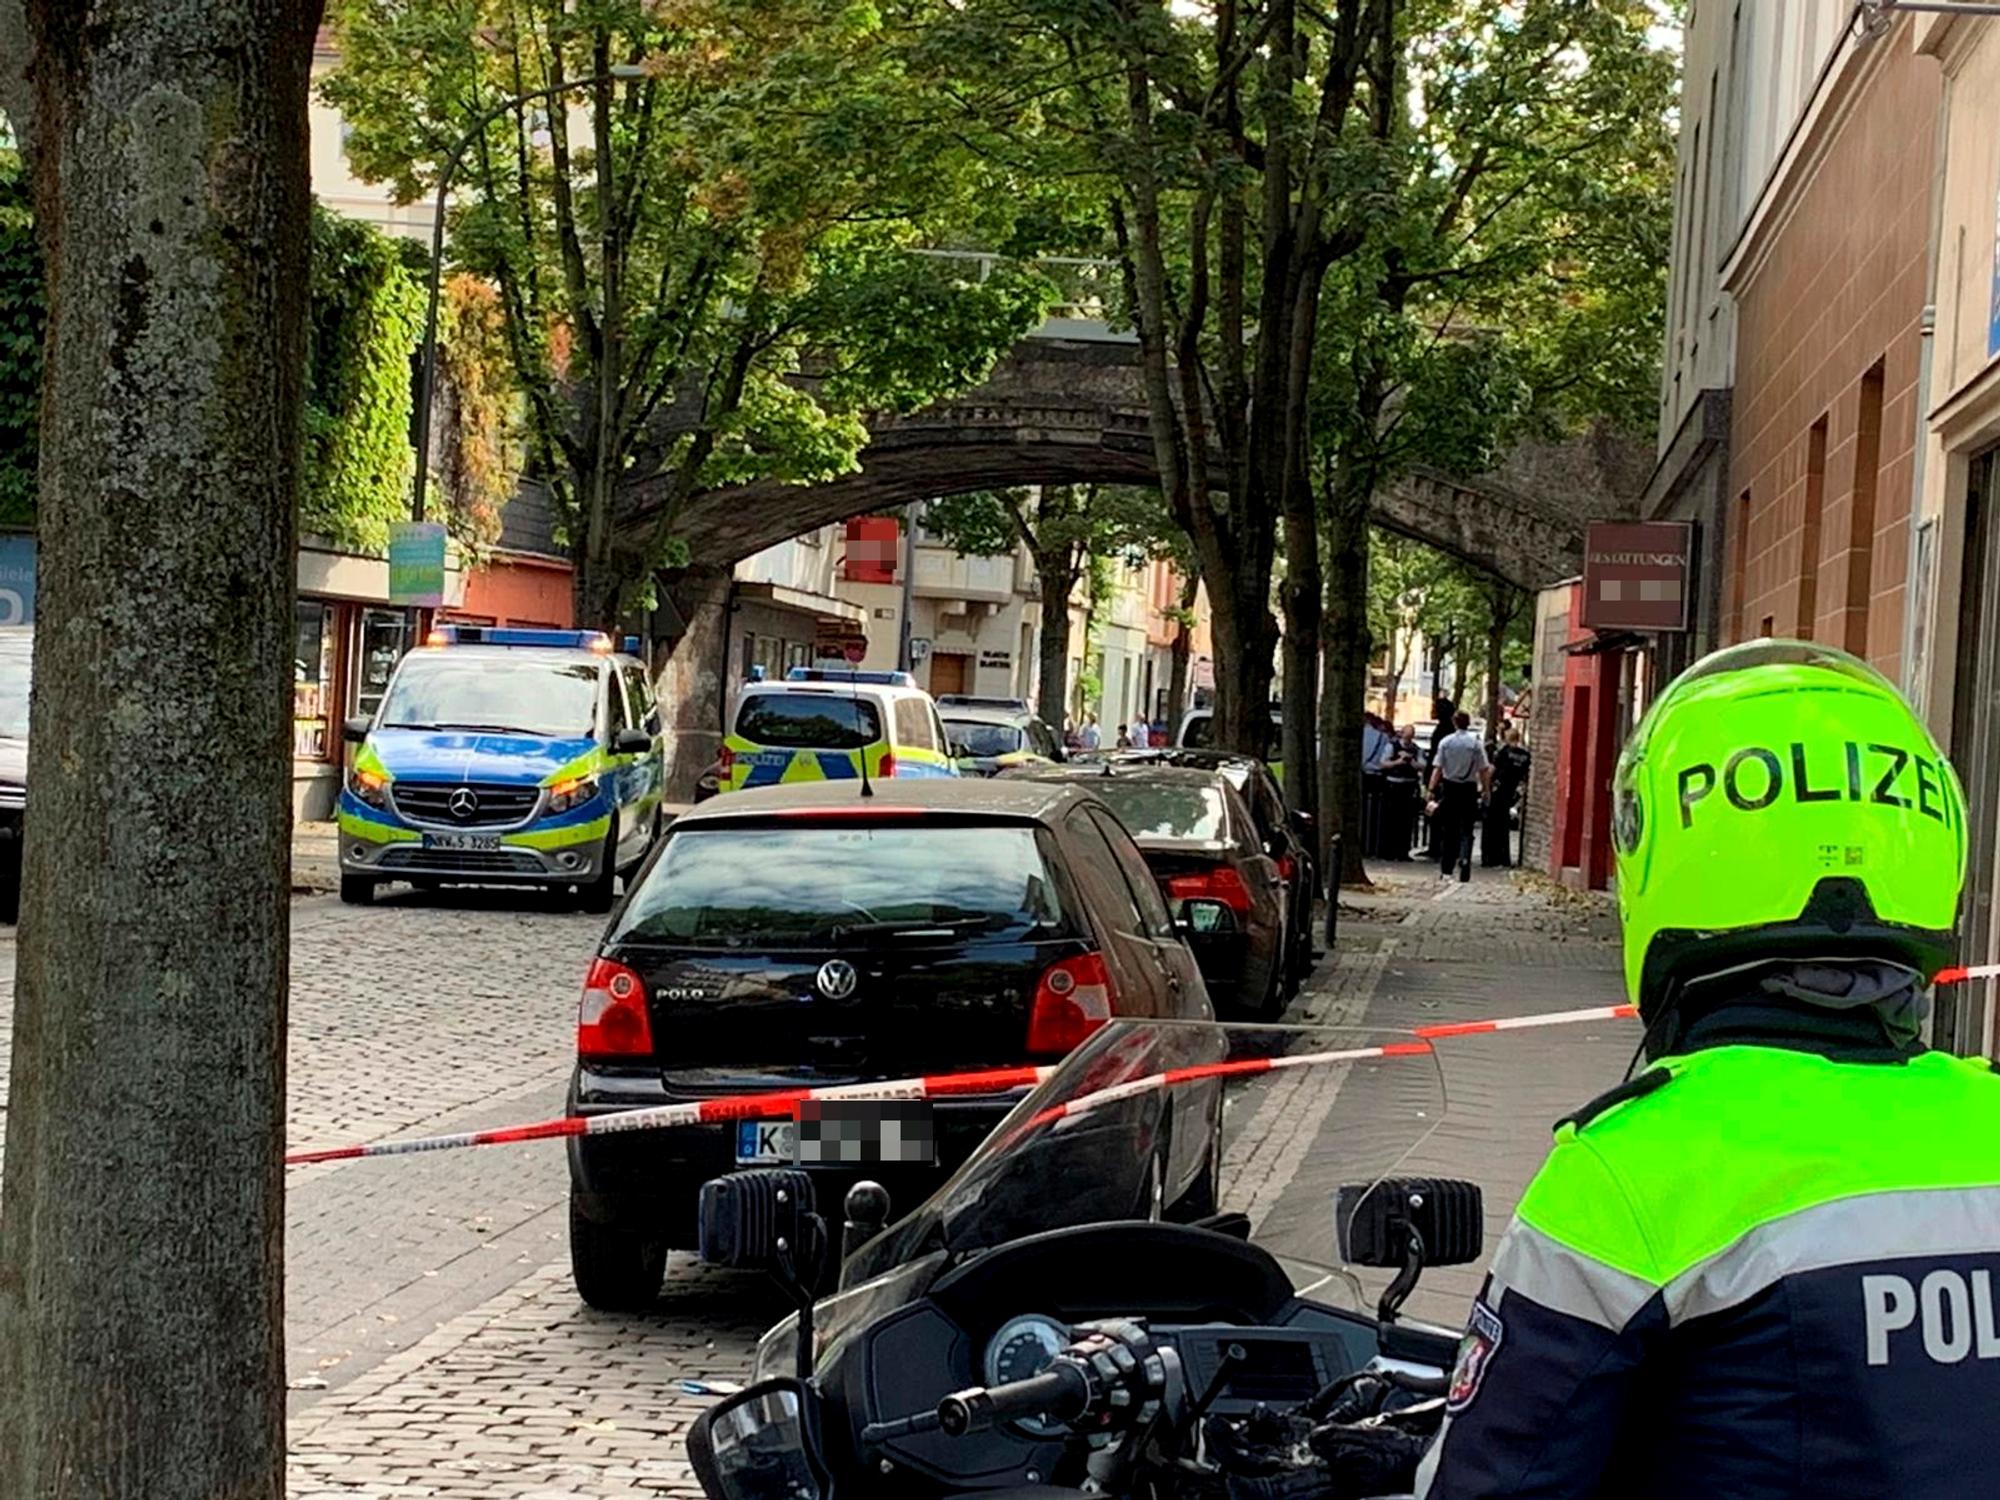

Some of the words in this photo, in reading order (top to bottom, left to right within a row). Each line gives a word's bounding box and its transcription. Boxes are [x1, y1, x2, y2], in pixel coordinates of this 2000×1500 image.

[734, 752, 787, 767] POLIZEI
[1677, 741, 1951, 830] POLIZEI
[656, 989, 704, 1000] POLO
[759, 1126, 778, 1155] K
[1862, 1269, 2000, 1366] POL
